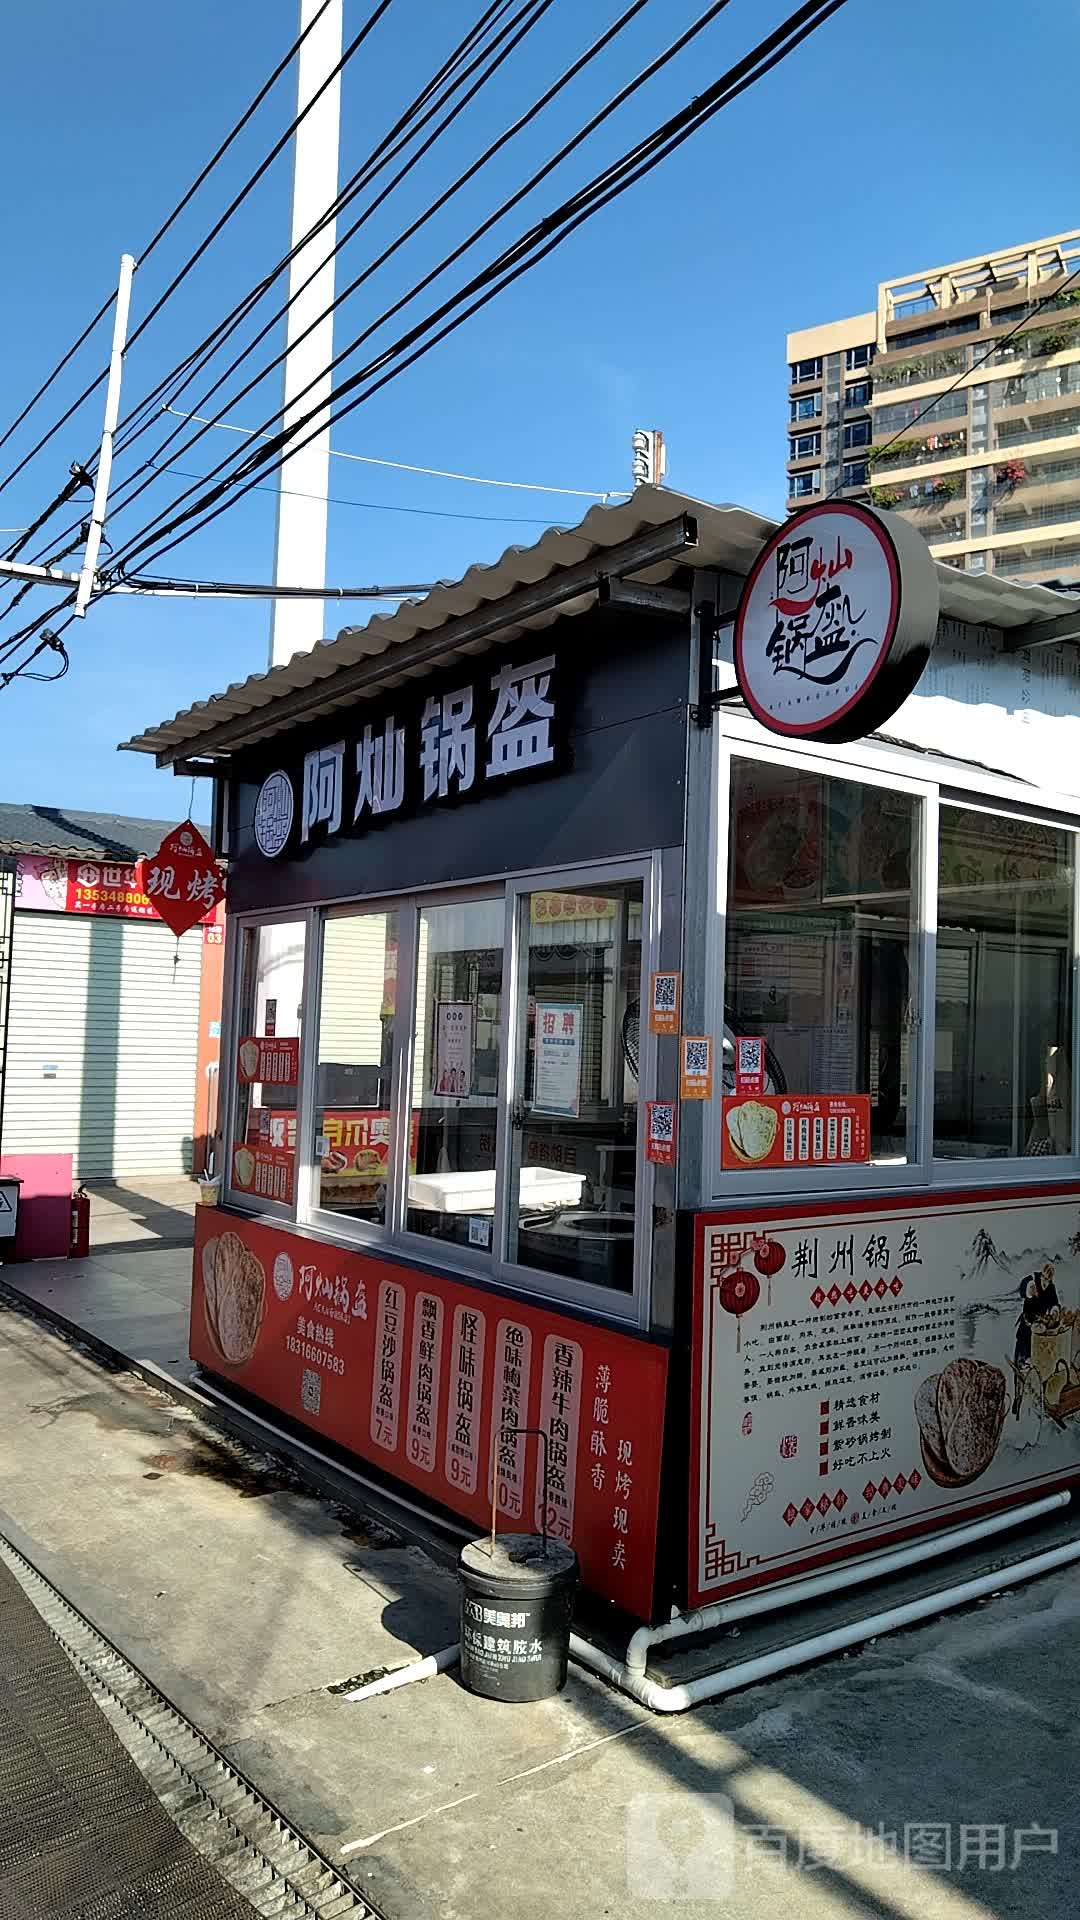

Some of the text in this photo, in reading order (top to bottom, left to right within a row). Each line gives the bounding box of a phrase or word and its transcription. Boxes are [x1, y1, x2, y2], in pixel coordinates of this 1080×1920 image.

[301, 654, 556, 845] 阿灿锅盔
[147, 866, 217, 909] 现烤
[543, 1011, 575, 1035] 招聘
[791, 1225, 923, 1279] 荆州锅盔
[297, 1316, 335, 1348] 美食热线
[379, 1287, 399, 1409] 红豆沙锅盔
[287, 1336, 345, 1376] 18316607583
[415, 1298, 437, 1427] 飘香鲜肉锅盔
[455, 1311, 478, 1447] 怪味锅盔
[546, 1342, 574, 1493] 香辣牛肉锅盔
[833, 1392, 880, 1411] 精选食材
[376, 1418, 393, 1445] 7元
[590, 1364, 611, 1491] 薄脆酥香
[411, 1438, 430, 1465] 9元
[451, 1458, 471, 1488] 9元
[832, 1447, 891, 1471] 好吃不上火
[611, 1439, 633, 1571] 现烤现卖
